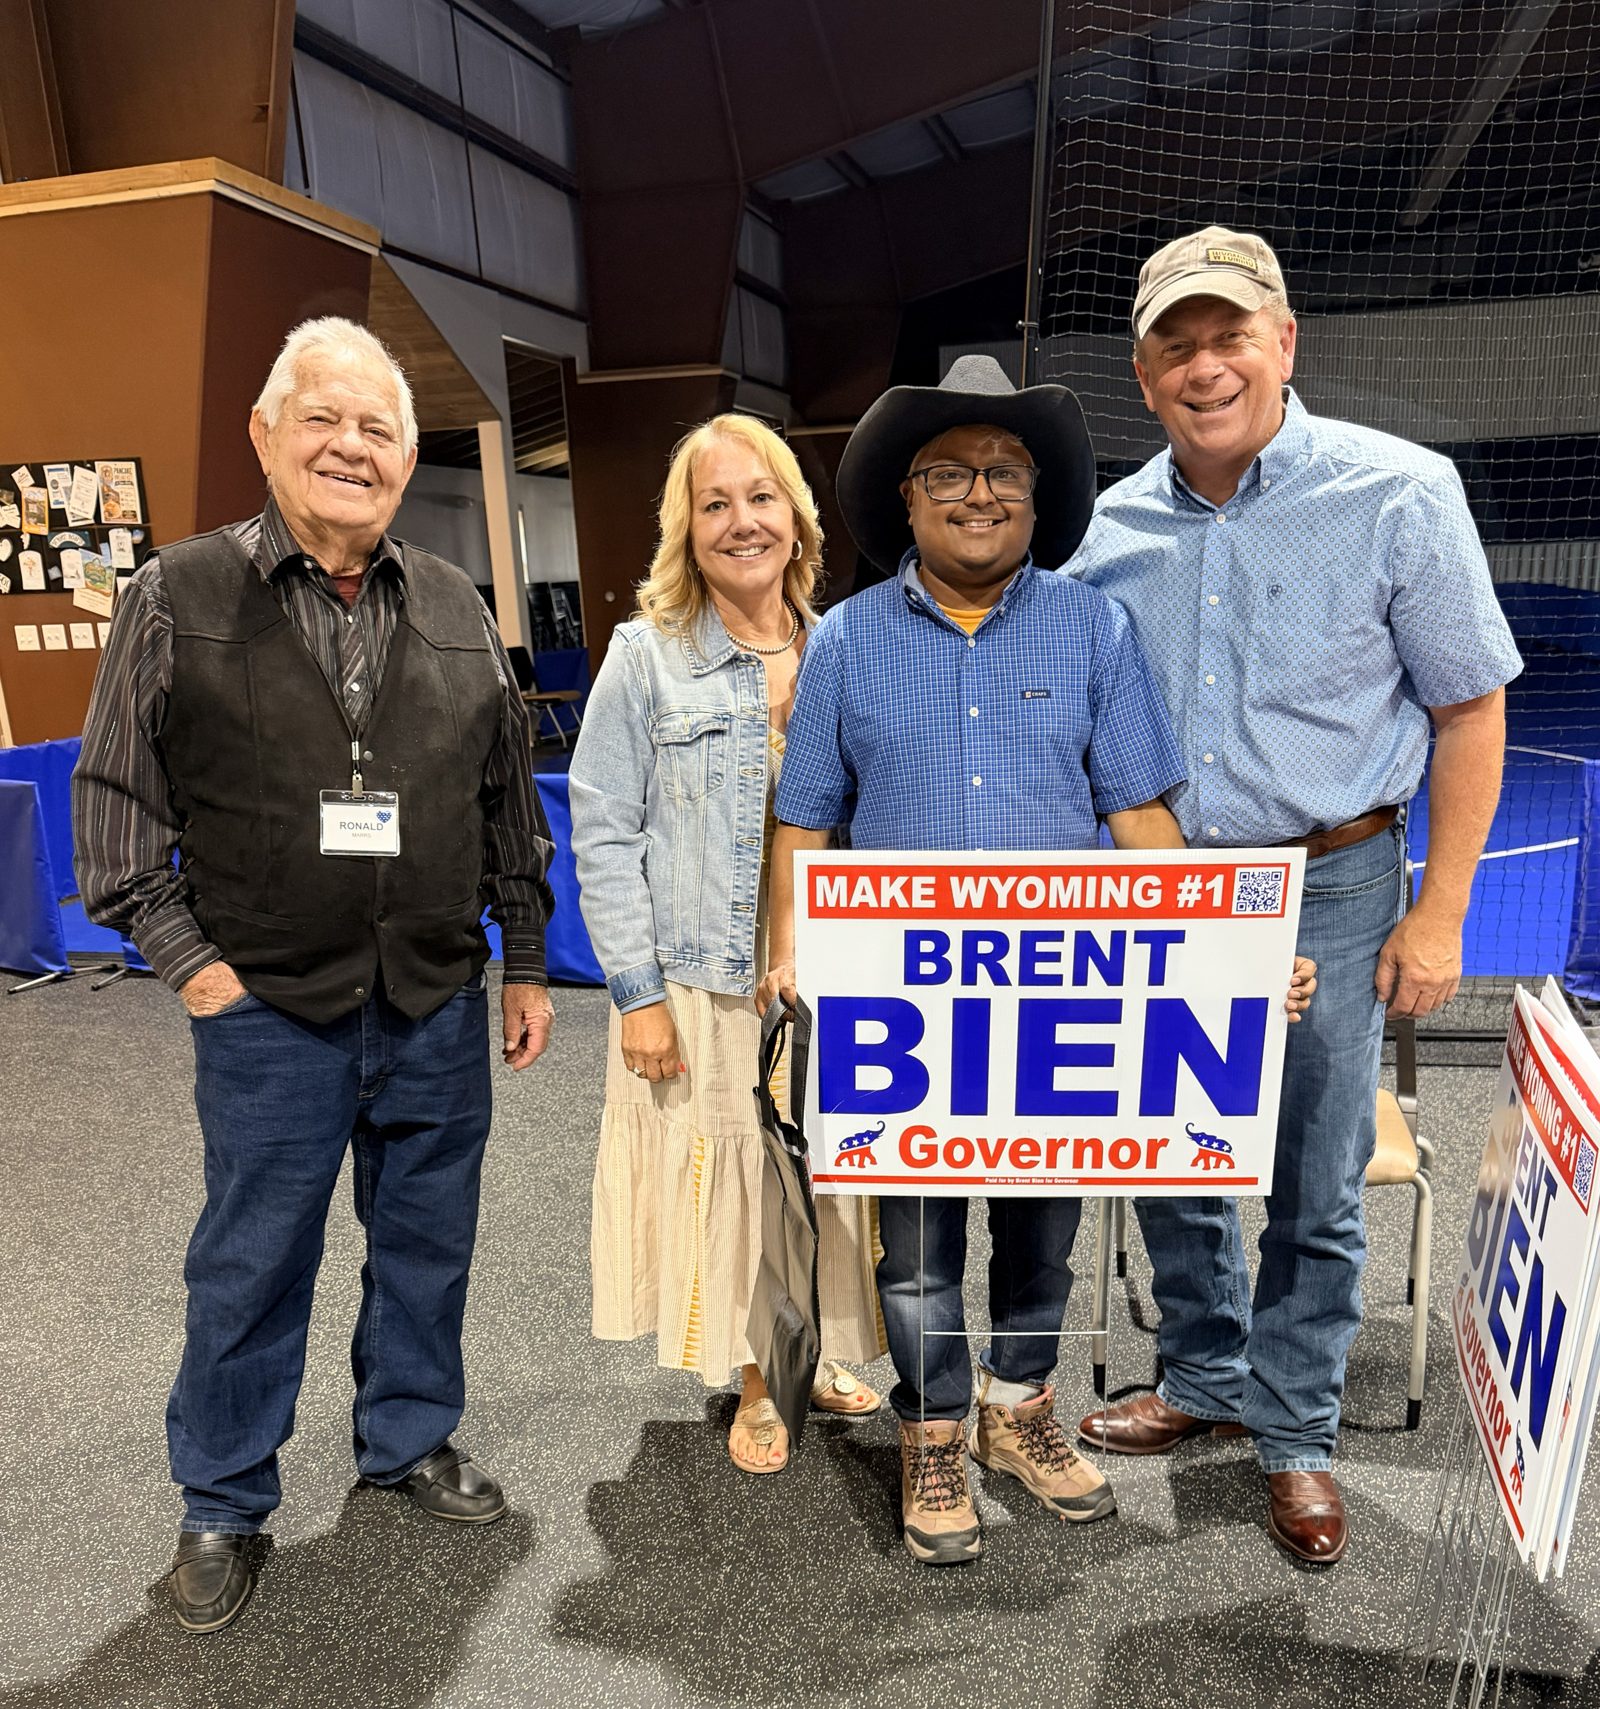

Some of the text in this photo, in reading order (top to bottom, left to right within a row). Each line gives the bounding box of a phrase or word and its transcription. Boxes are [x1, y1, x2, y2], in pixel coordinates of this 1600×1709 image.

[339, 821, 384, 831] RONALD
[815, 873, 1225, 908] MAKE WYOMING #1
[903, 929, 1186, 987] BRENT
[817, 995, 1270, 1117] BIEN
[898, 1124, 1170, 1171] Governor
[1521, 1052, 1563, 1147] WYOMING
[1559, 1121, 1578, 1173] #1
[1467, 1128, 1567, 1454] BIEN
[1461, 1287, 1512, 1456] Governor
